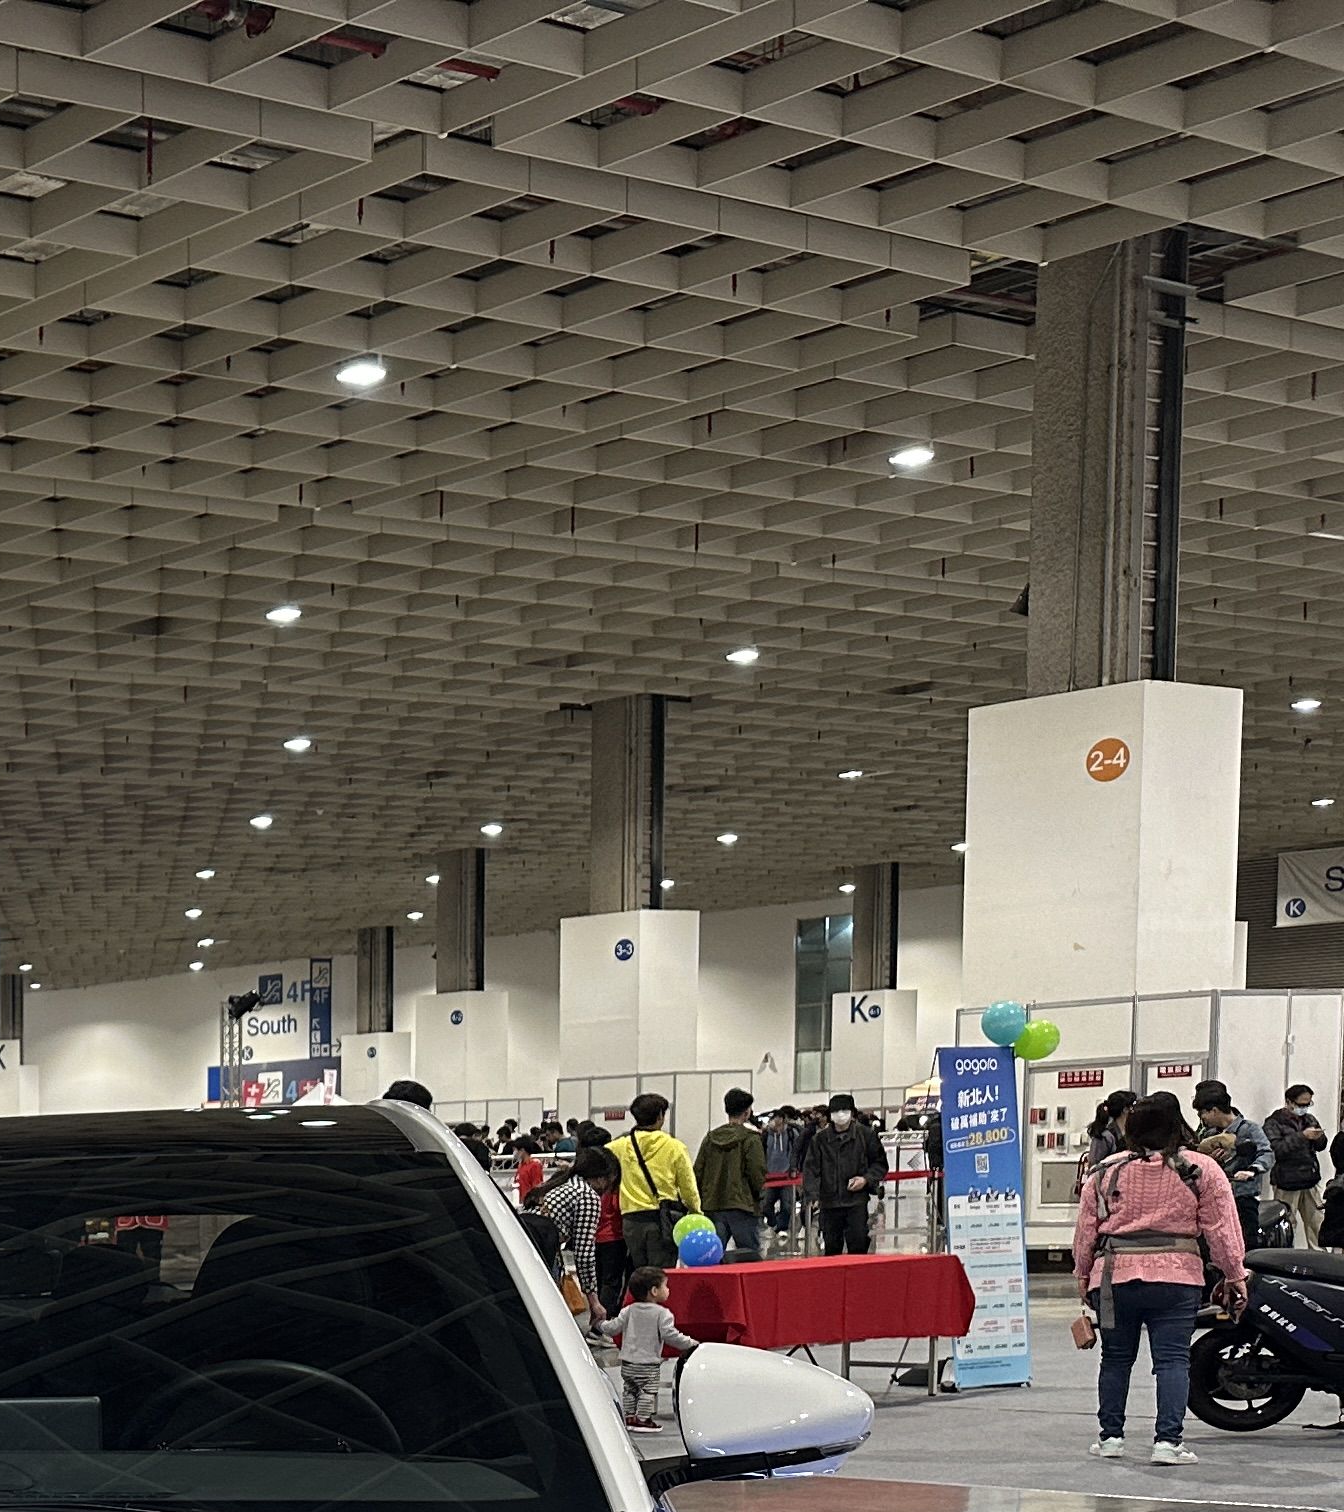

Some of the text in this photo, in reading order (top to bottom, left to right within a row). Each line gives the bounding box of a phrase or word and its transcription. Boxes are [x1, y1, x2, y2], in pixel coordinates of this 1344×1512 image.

[1089, 746, 1127, 772] 2-4
[312, 987, 329, 1005] 4F
[850, 994, 869, 1024] K
[247, 1014, 298, 1037] South
[955, 1058, 998, 1076] gogoro
